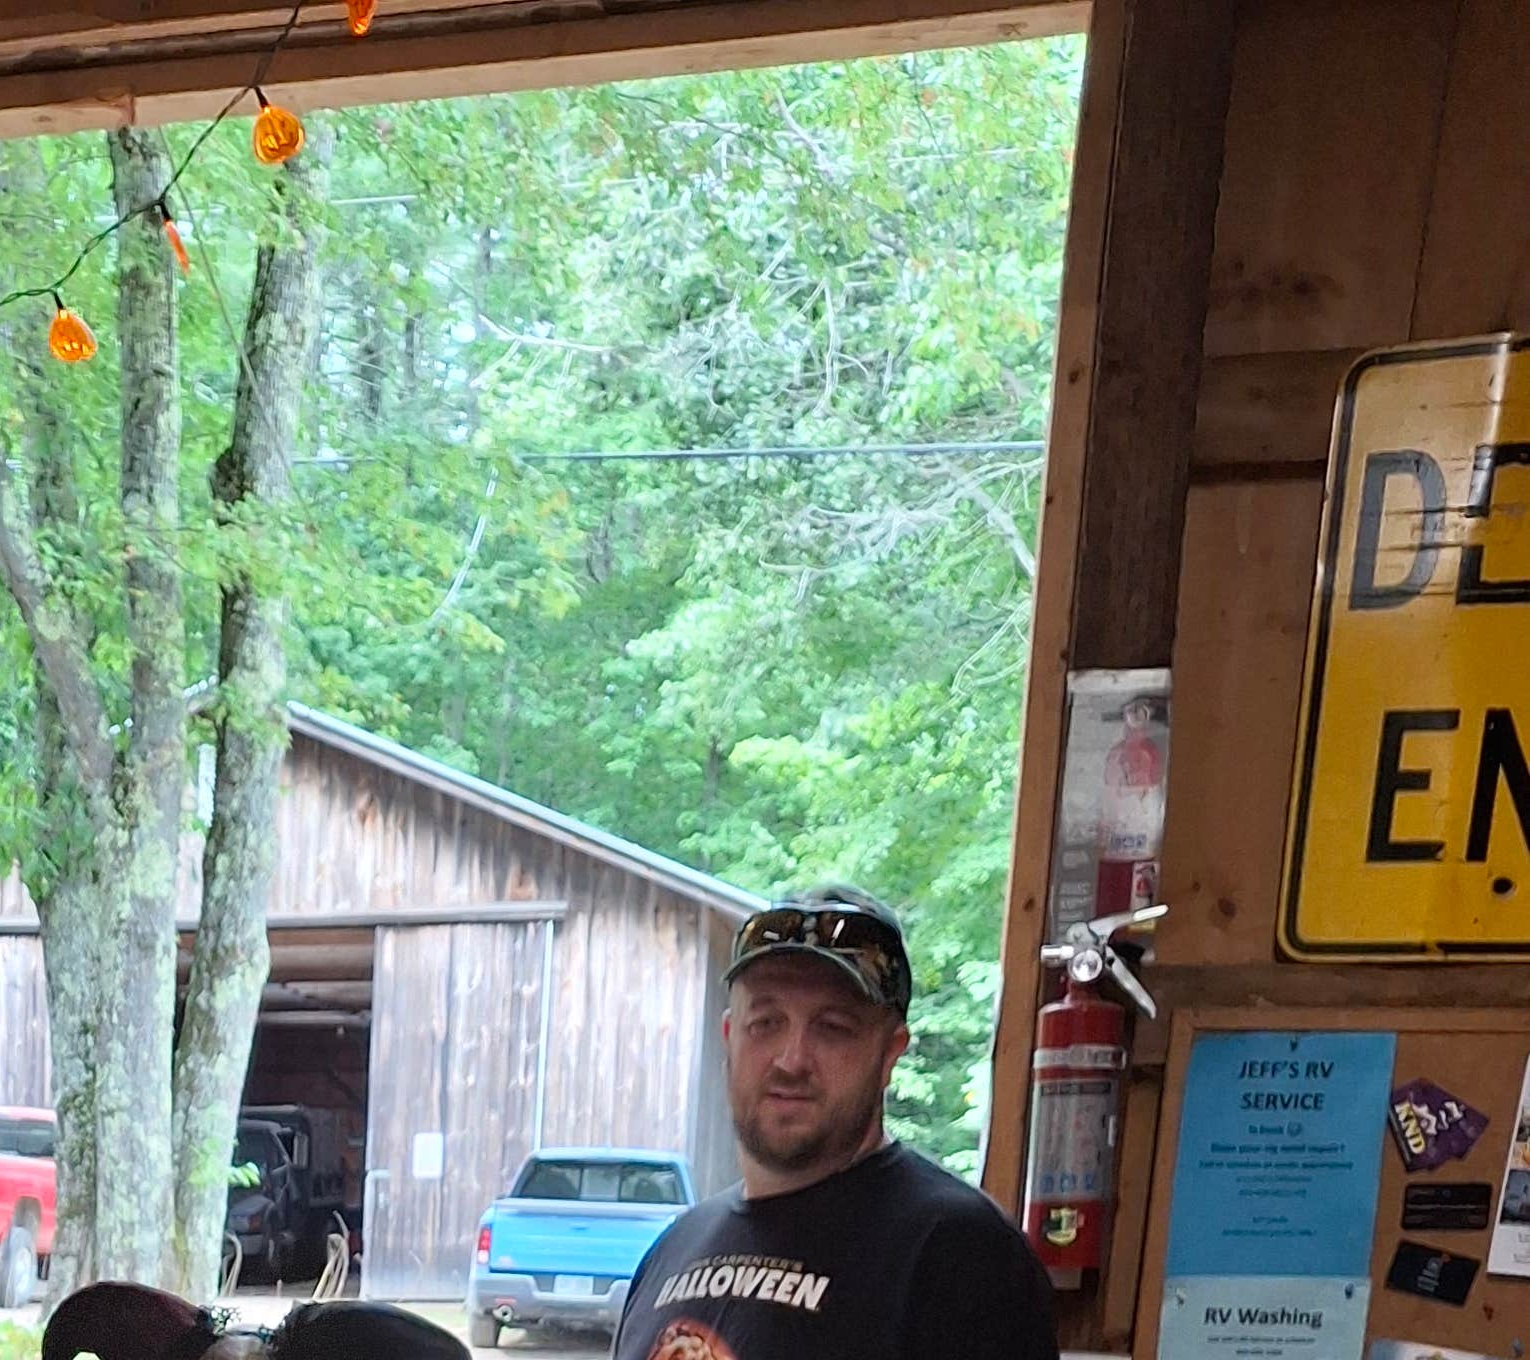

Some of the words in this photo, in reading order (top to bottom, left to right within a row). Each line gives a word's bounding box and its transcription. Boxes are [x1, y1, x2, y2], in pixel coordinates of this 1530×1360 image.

[1239, 1060, 1300, 1080] JEFF'S
[1304, 1061, 1335, 1079] RV
[1240, 1092, 1326, 1111] SERVICE
[1203, 1306, 1232, 1326] RV
[1238, 1307, 1323, 1329] Washing
